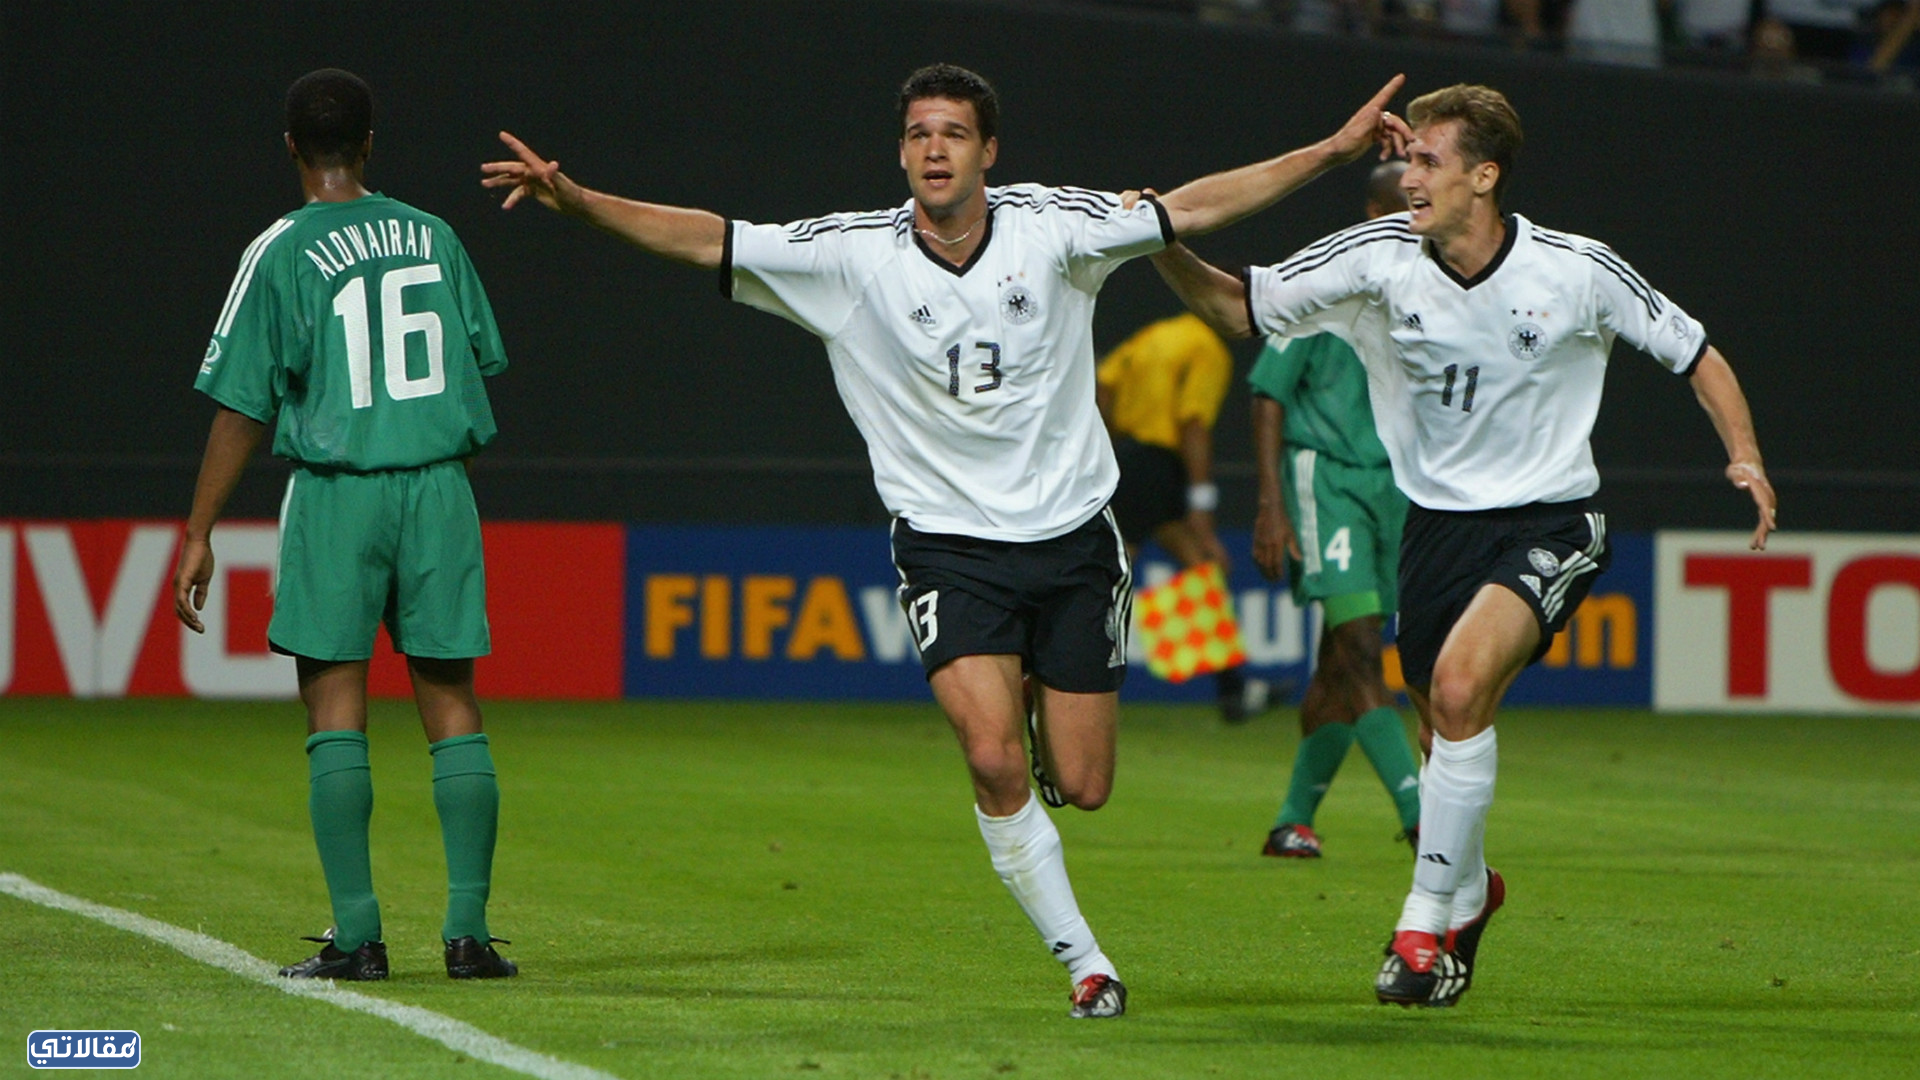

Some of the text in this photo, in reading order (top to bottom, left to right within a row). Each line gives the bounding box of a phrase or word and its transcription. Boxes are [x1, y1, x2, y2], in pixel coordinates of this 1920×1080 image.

[332, 263, 446, 409] 16
[946, 341, 1001, 396] 13
[1441, 363, 1480, 413] 11
[1324, 526, 1352, 571] 4
[1683, 554, 1920, 704] TO
